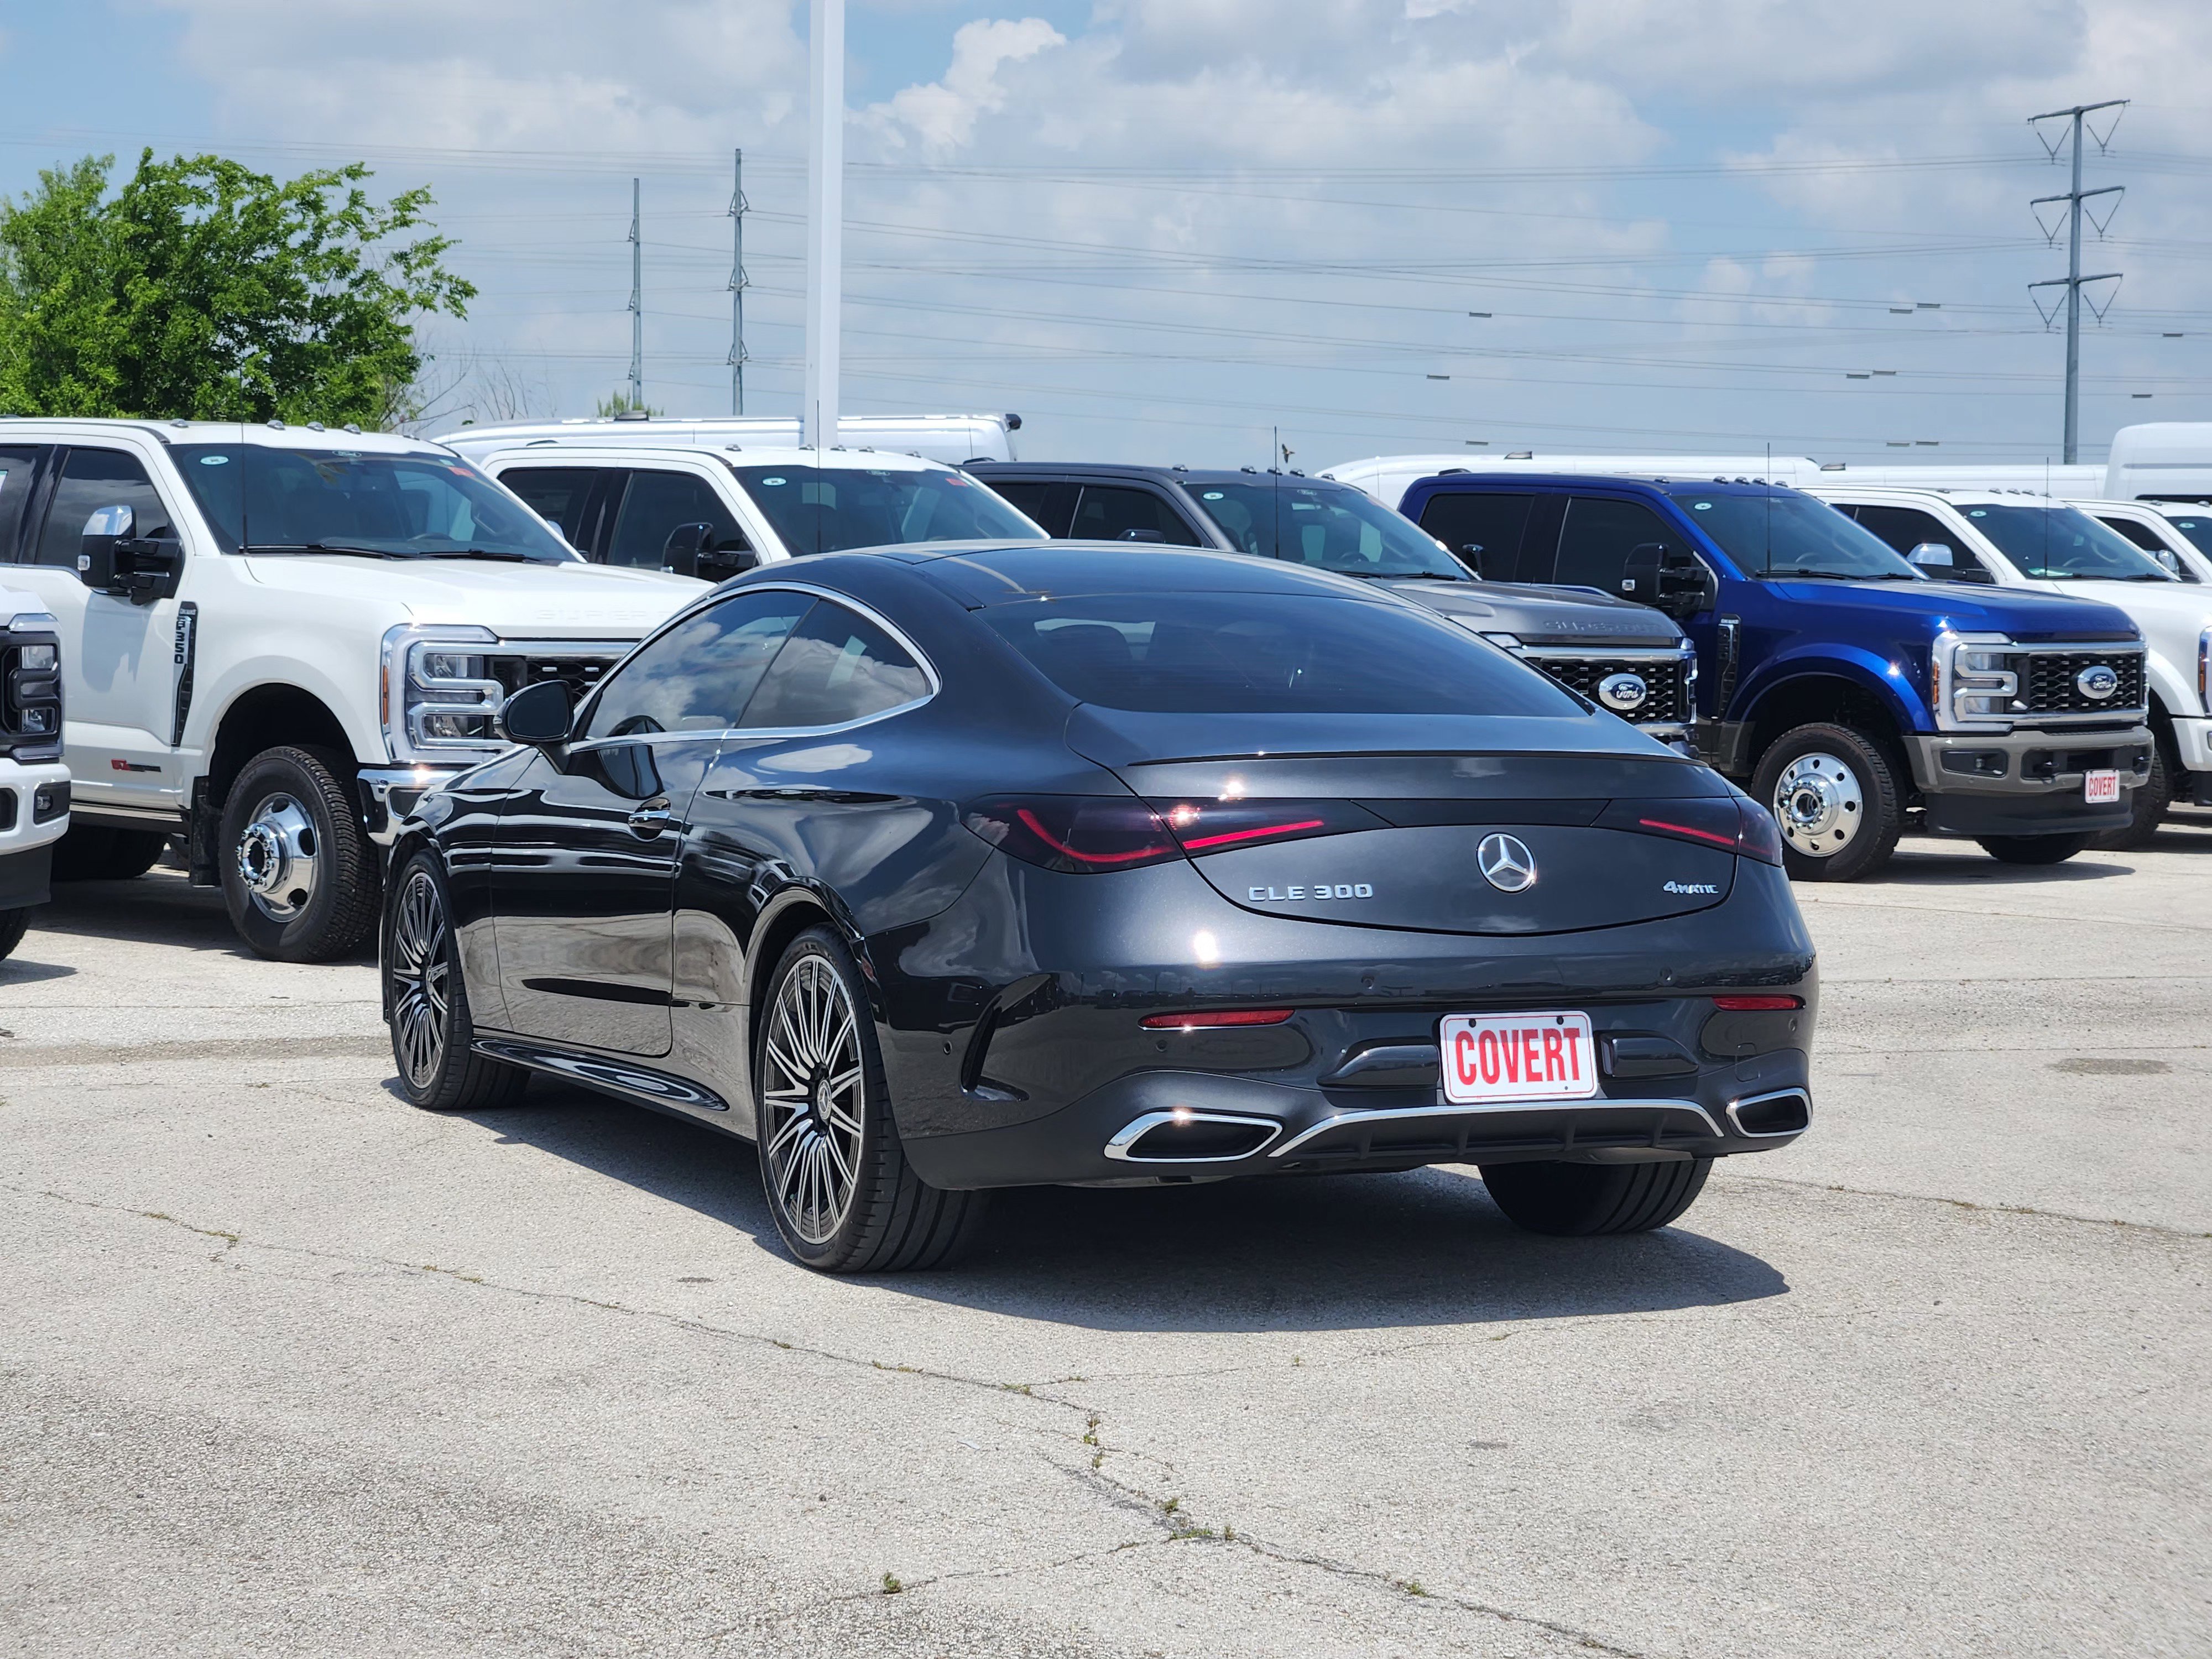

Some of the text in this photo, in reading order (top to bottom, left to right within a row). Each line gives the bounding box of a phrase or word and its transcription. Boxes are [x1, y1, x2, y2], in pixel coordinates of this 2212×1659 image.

[1616, 684, 1639, 698] Ford
[2089, 776, 2116, 796] COVERT
[1249, 884, 1373, 901] CLE 300
[1663, 880, 1719, 894] 4MATIC
[1455, 1027, 1580, 1086] COVERT
